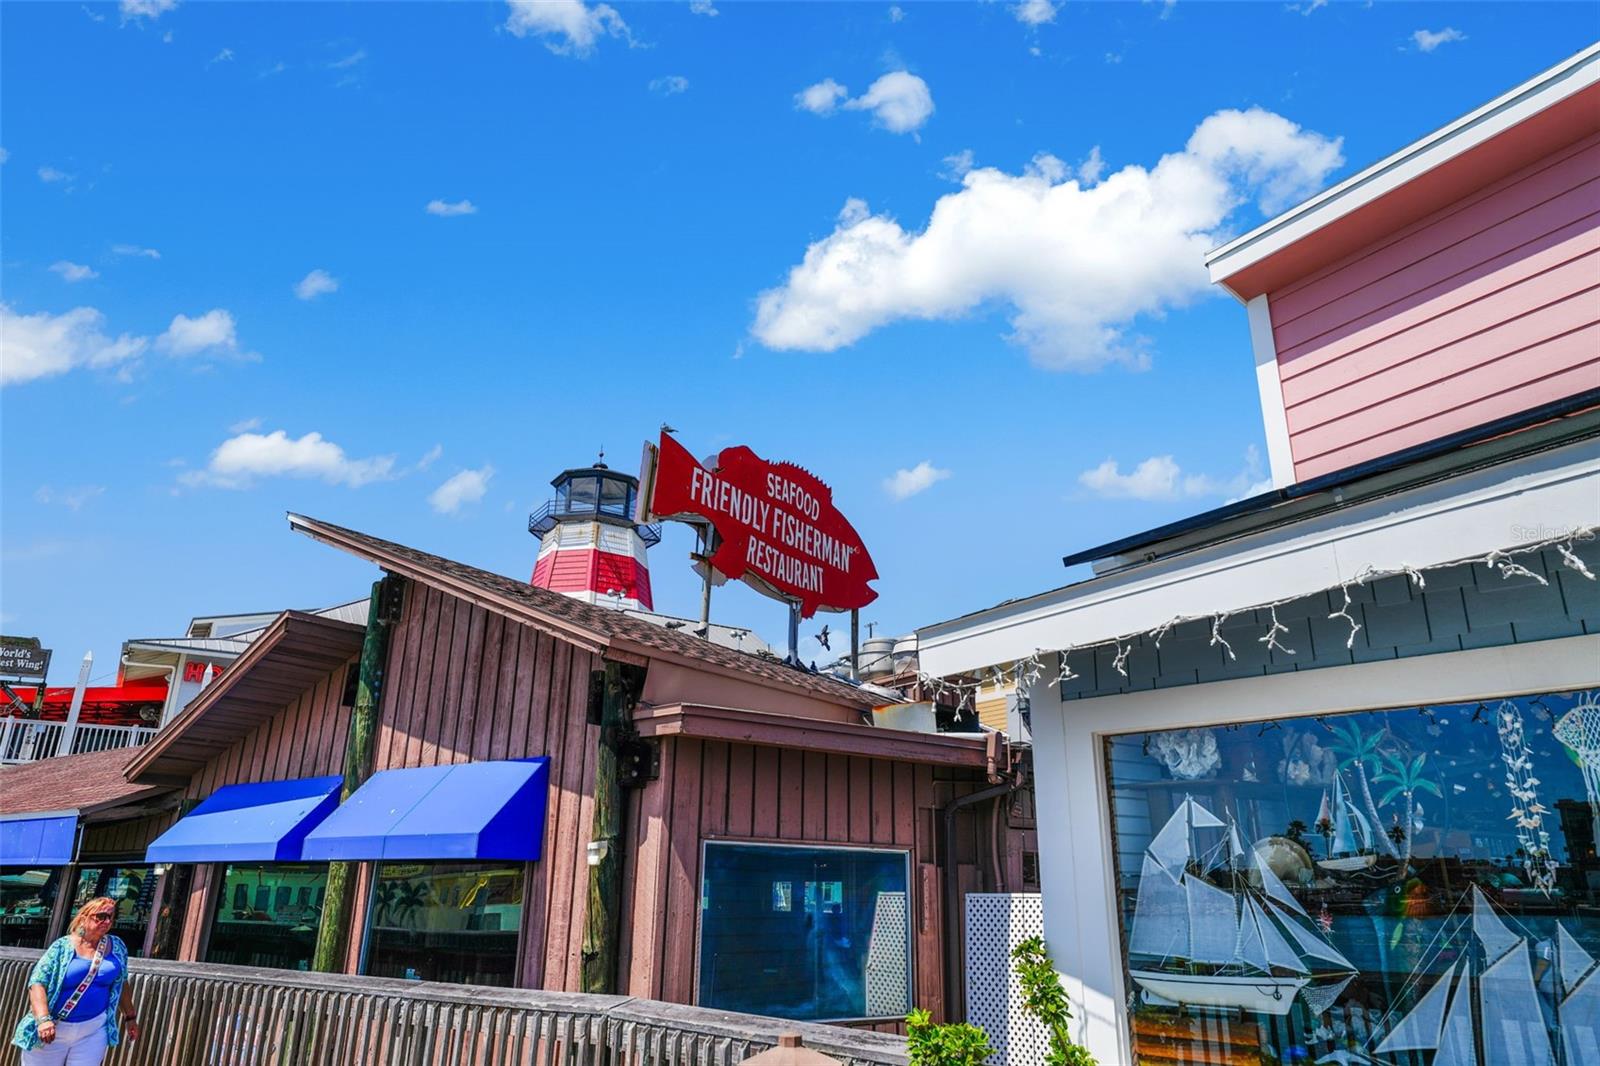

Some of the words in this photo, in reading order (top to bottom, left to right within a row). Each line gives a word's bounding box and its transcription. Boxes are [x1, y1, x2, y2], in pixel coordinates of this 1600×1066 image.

[690, 467, 770, 533] FRIENDLY
[772, 507, 851, 573] FISHERMAN
[767, 473, 820, 521] SEAFOOD
[747, 535, 824, 594] RESTAURANT
[17, 659, 43, 671] Wing!
